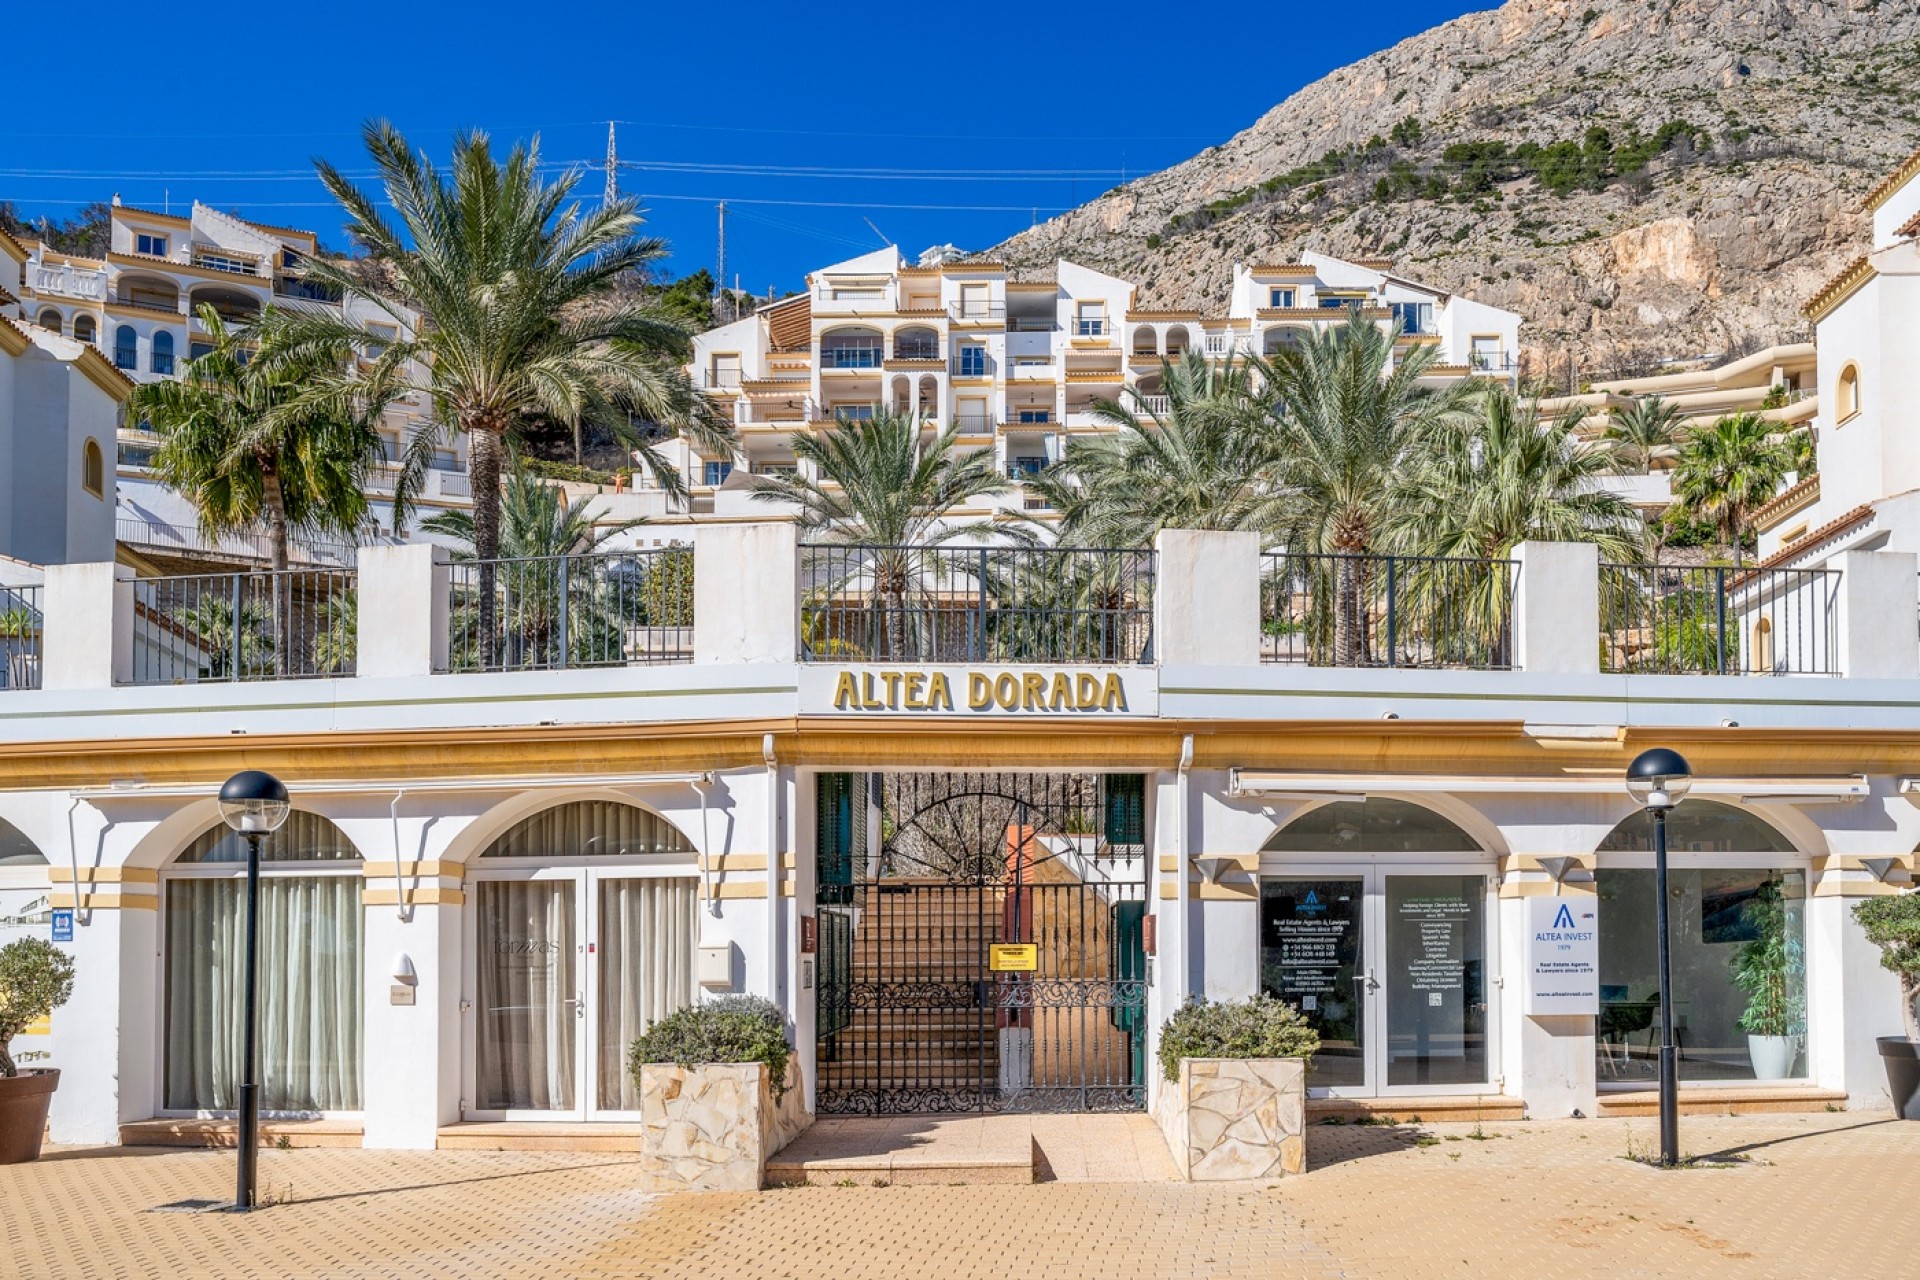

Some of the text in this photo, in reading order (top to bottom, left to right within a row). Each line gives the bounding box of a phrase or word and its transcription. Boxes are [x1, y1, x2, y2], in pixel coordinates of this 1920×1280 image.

[834, 671, 1125, 709] ALTEA DORADA
[1302, 919, 1322, 927] Agents
[1328, 919, 1350, 927] Lawyers
[1536, 932, 1593, 941] ALTEA INVEST
[494, 938, 560, 954] formas
